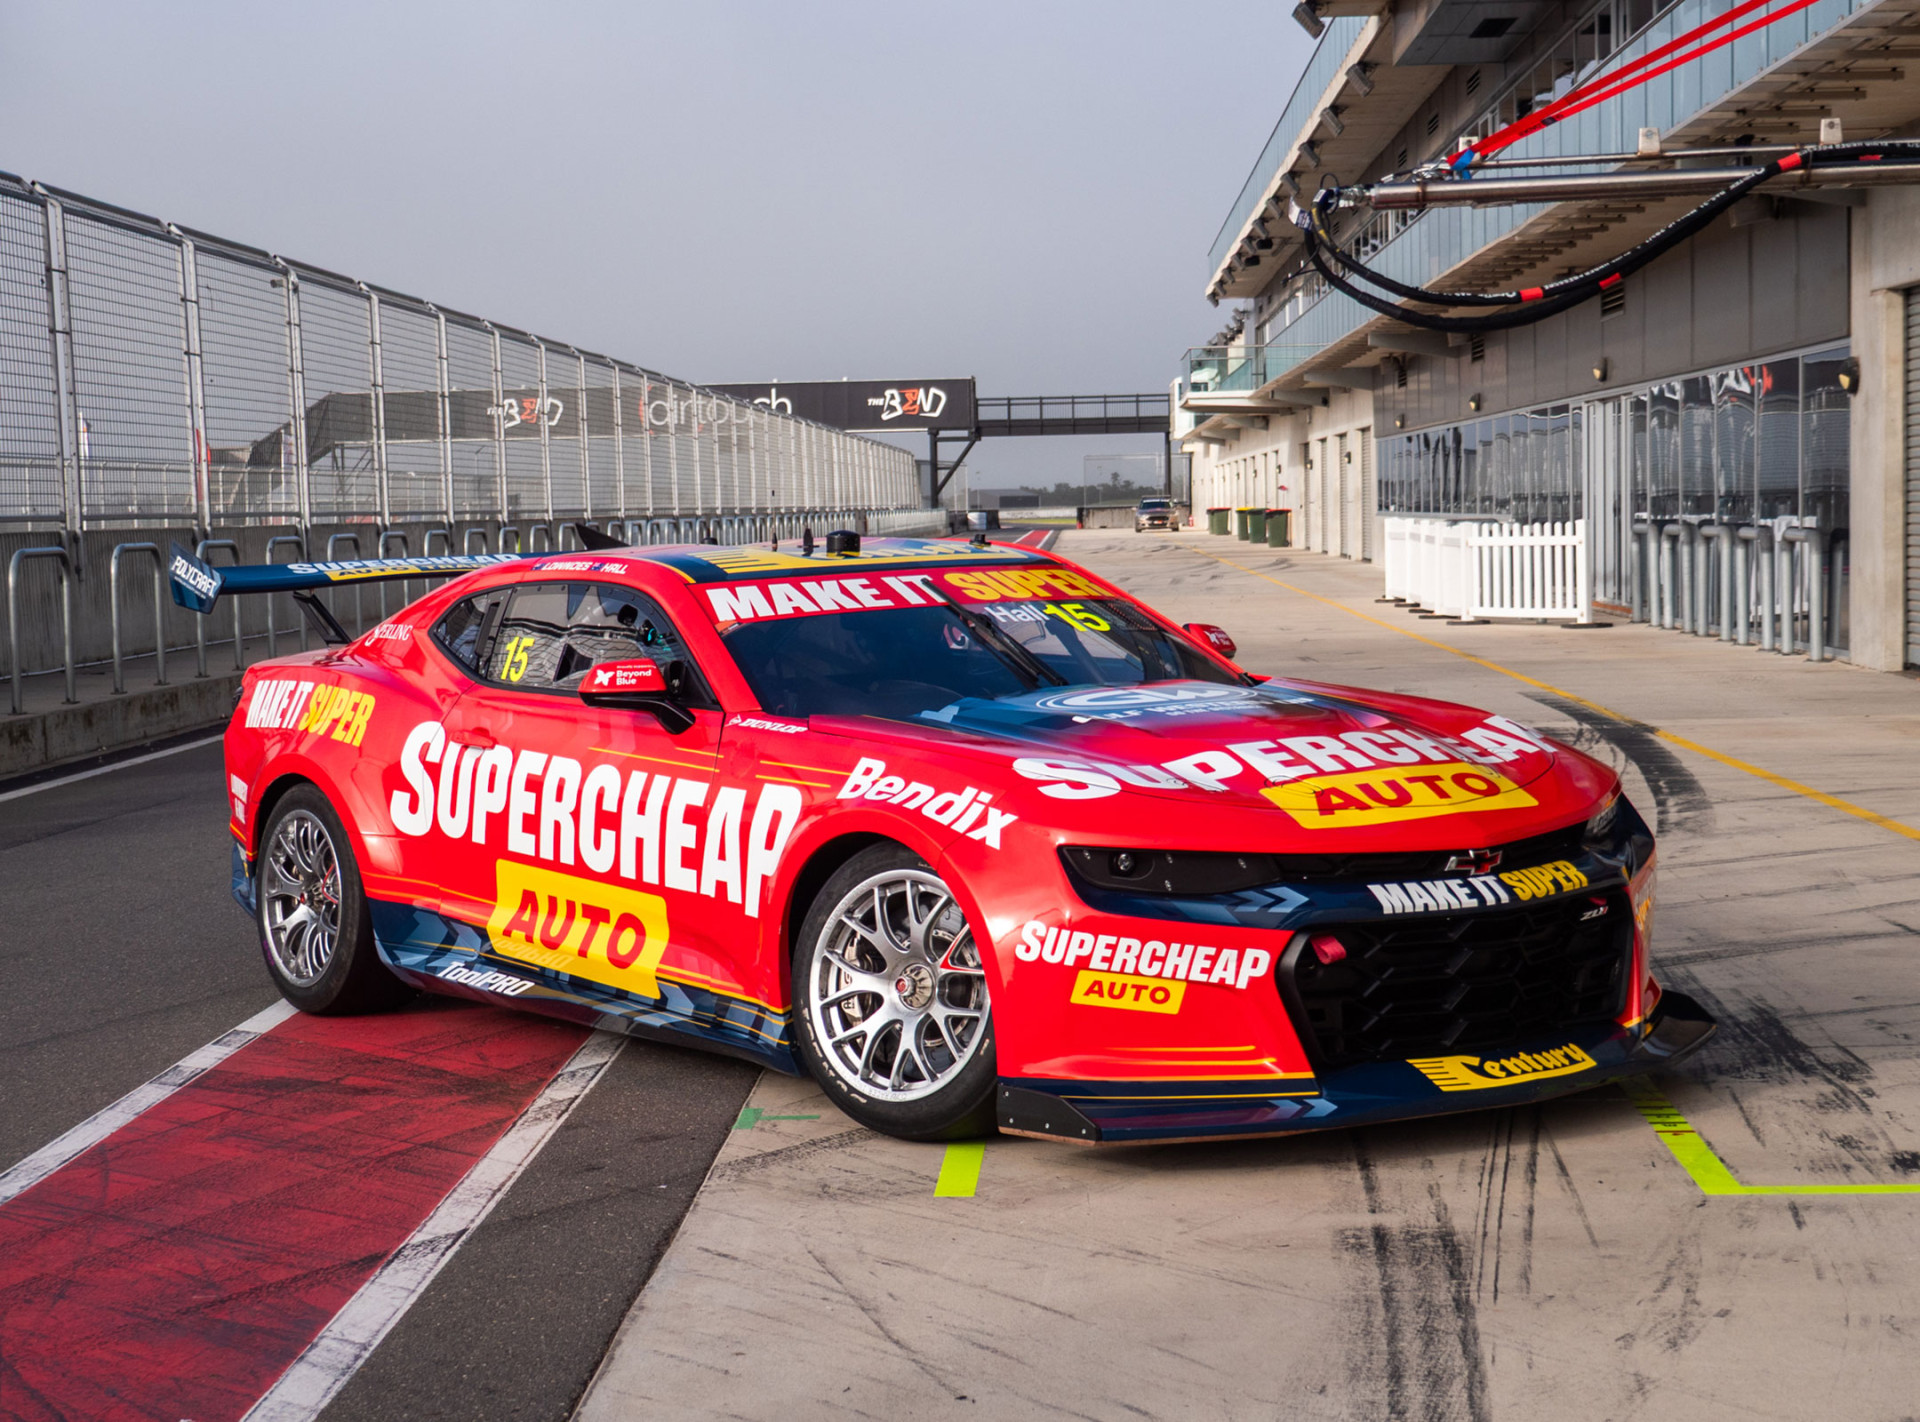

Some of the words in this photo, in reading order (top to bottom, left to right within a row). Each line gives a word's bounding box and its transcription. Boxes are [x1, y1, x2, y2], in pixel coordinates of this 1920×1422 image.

[866, 397, 885, 406] THE
[881, 387, 947, 420] BEND
[171, 555, 217, 598] POLYCRAFT
[287, 553, 522, 574] SUPERCHEAP
[338, 566, 410, 577] AUTO
[541, 561, 593, 571] LOWNDES
[600, 563, 629, 574] HALL
[705, 579, 895, 622] MAKE
[888, 574, 948, 605] IT
[944, 569, 1114, 601] SUPER
[984, 604, 1050, 623] Hall
[1042, 603, 1112, 632] 15
[501, 637, 535, 682] 15
[616, 669, 652, 679] Beyond
[616, 677, 637, 686] Blue
[245, 680, 300, 728] MAKE
[281, 681, 315, 729] IT
[298, 683, 376, 747] SUPER
[738, 718, 809, 734] DUNLOP
[1012, 713, 1558, 799] SUPERCHEAP
[836, 757, 1018, 849] Bendix
[1313, 771, 1500, 816] AUTO
[390, 721, 802, 918] SUPERCHEAP
[1367, 878, 1478, 915] MAKE
[1468, 875, 1509, 906] IT
[1499, 860, 1588, 901] SUPER
[502, 889, 647, 970] AUTO
[1015, 920, 1271, 989] SUPERCHEAP
[437, 960, 535, 997] ToolPRO
[1083, 979, 1172, 1004] AUTO
